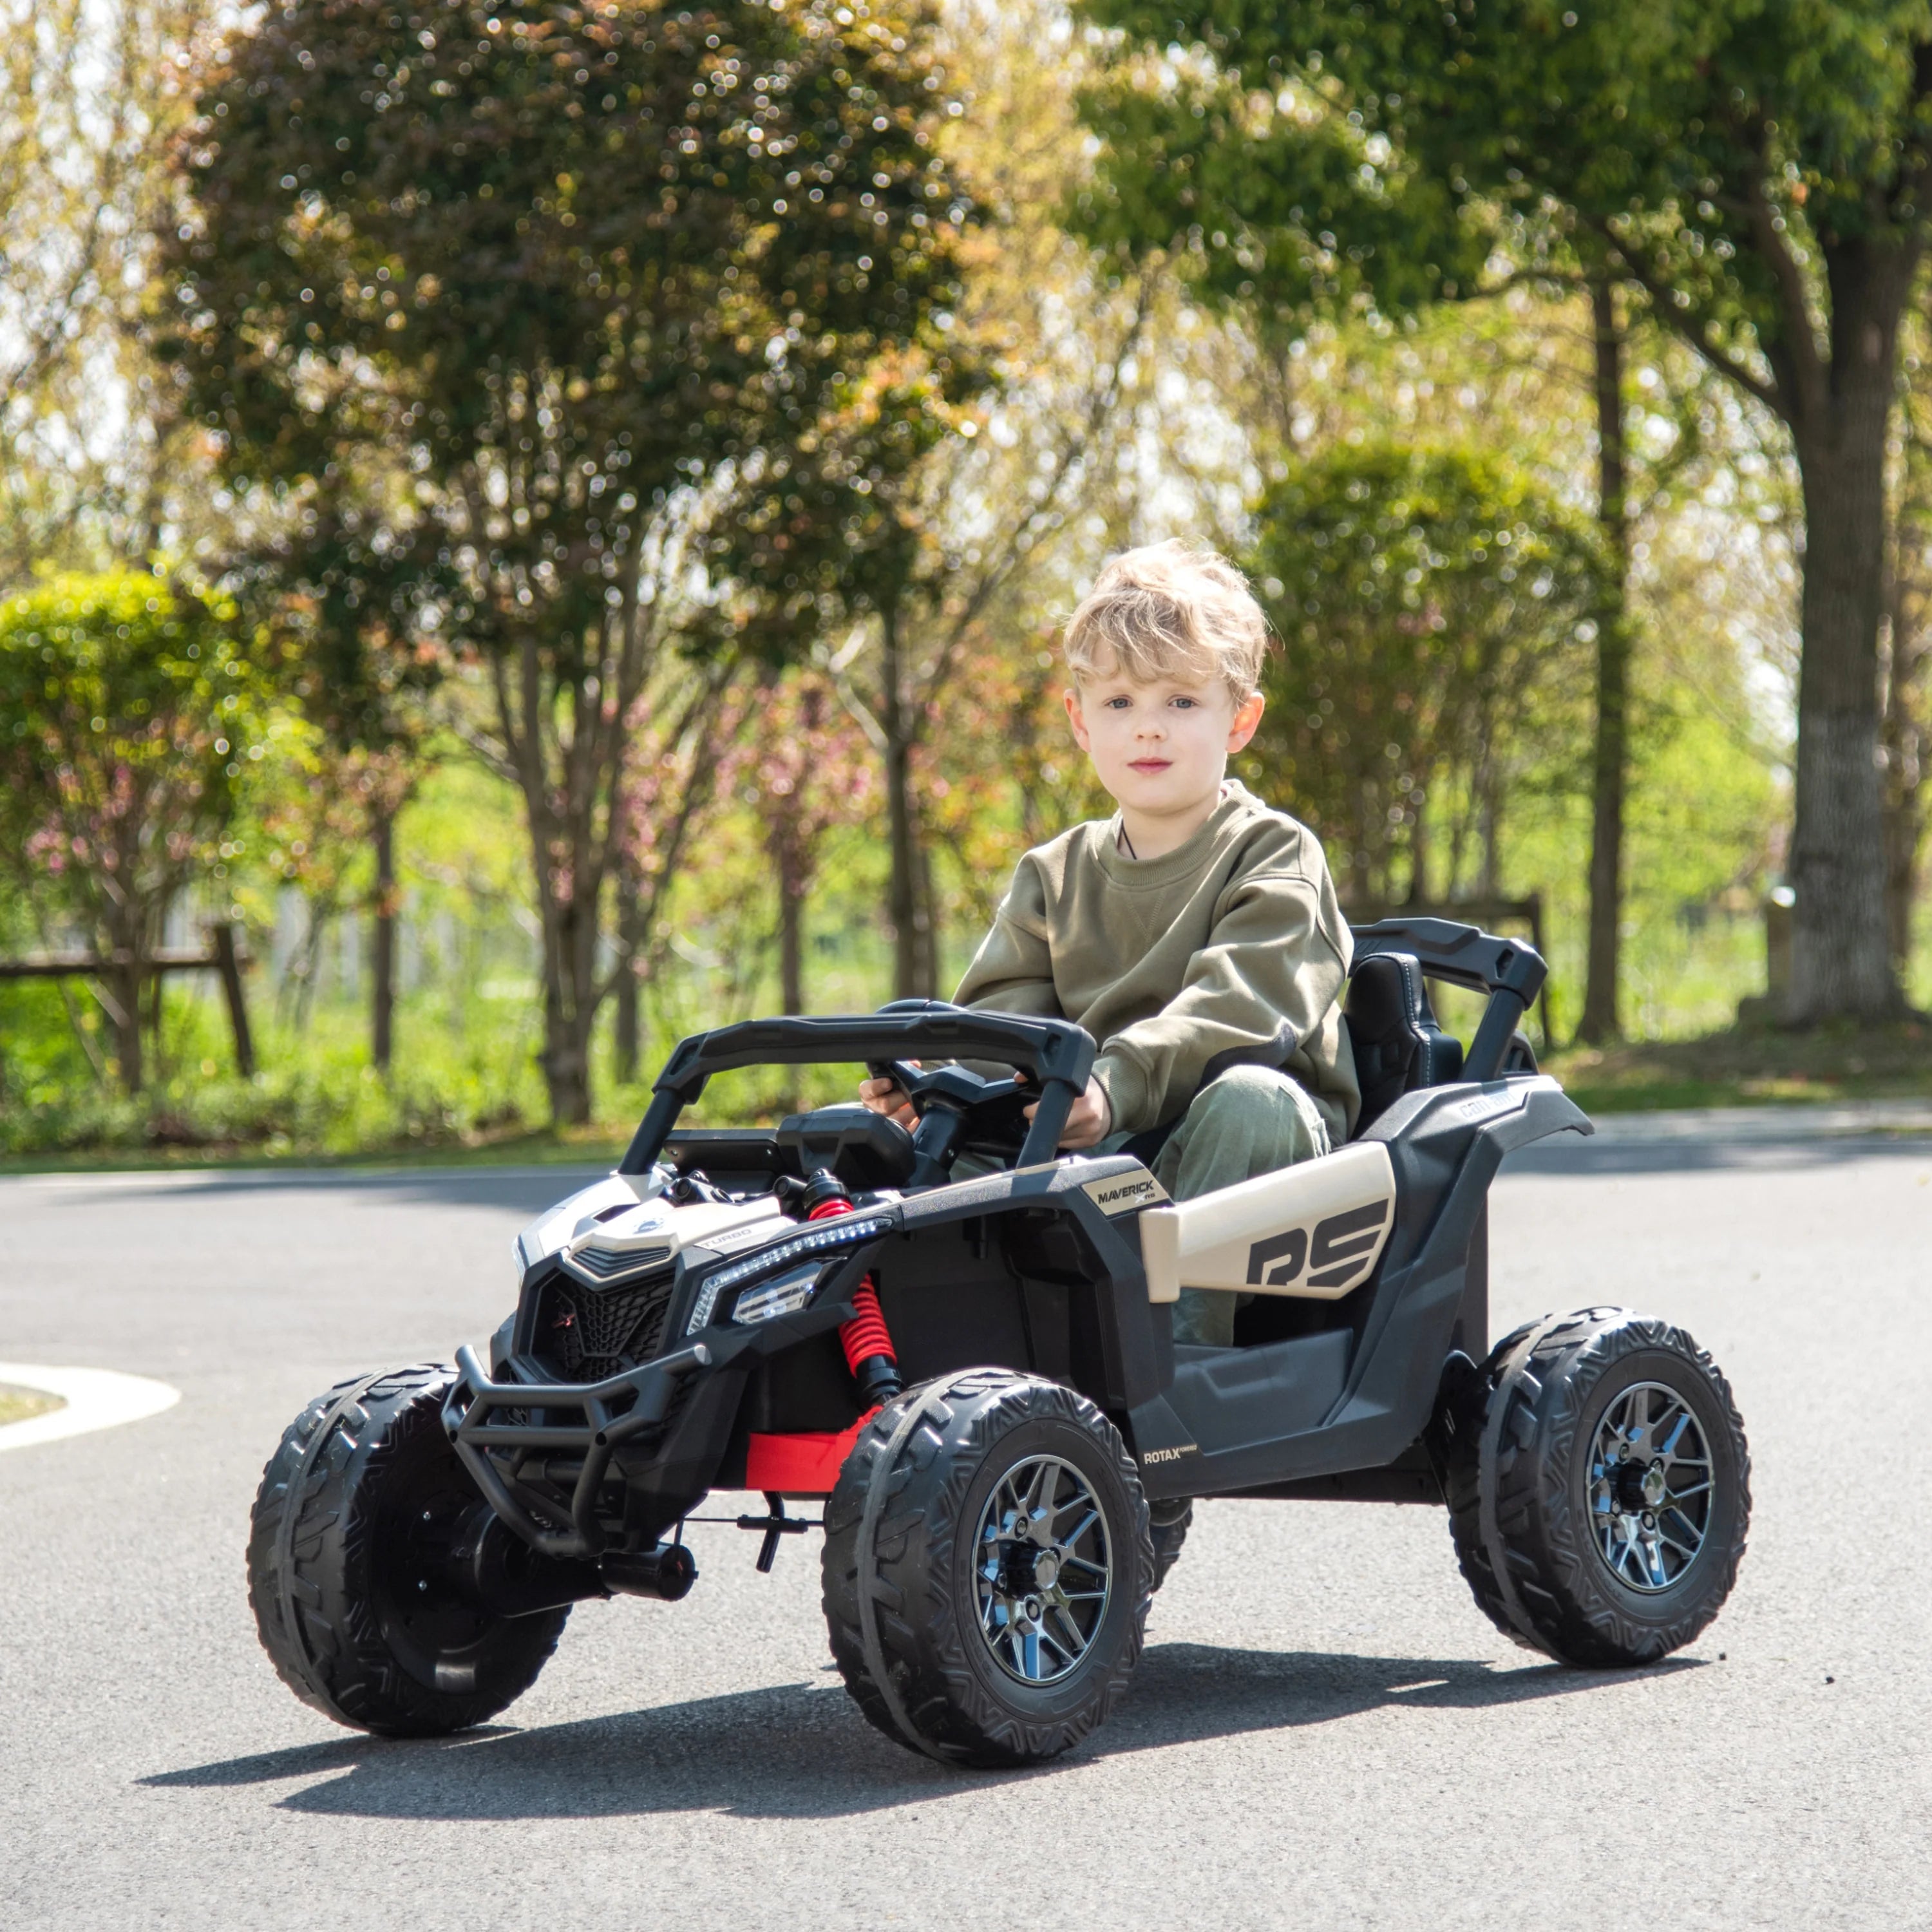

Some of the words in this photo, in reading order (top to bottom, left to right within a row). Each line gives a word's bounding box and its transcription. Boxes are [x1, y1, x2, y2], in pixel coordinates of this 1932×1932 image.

[1097, 1180, 1154, 1204] MAVERICK
[701, 1229, 752, 1247] TURBO
[1246, 1198, 1389, 1287] RS
[1144, 1448, 1181, 1464] ROTAX
